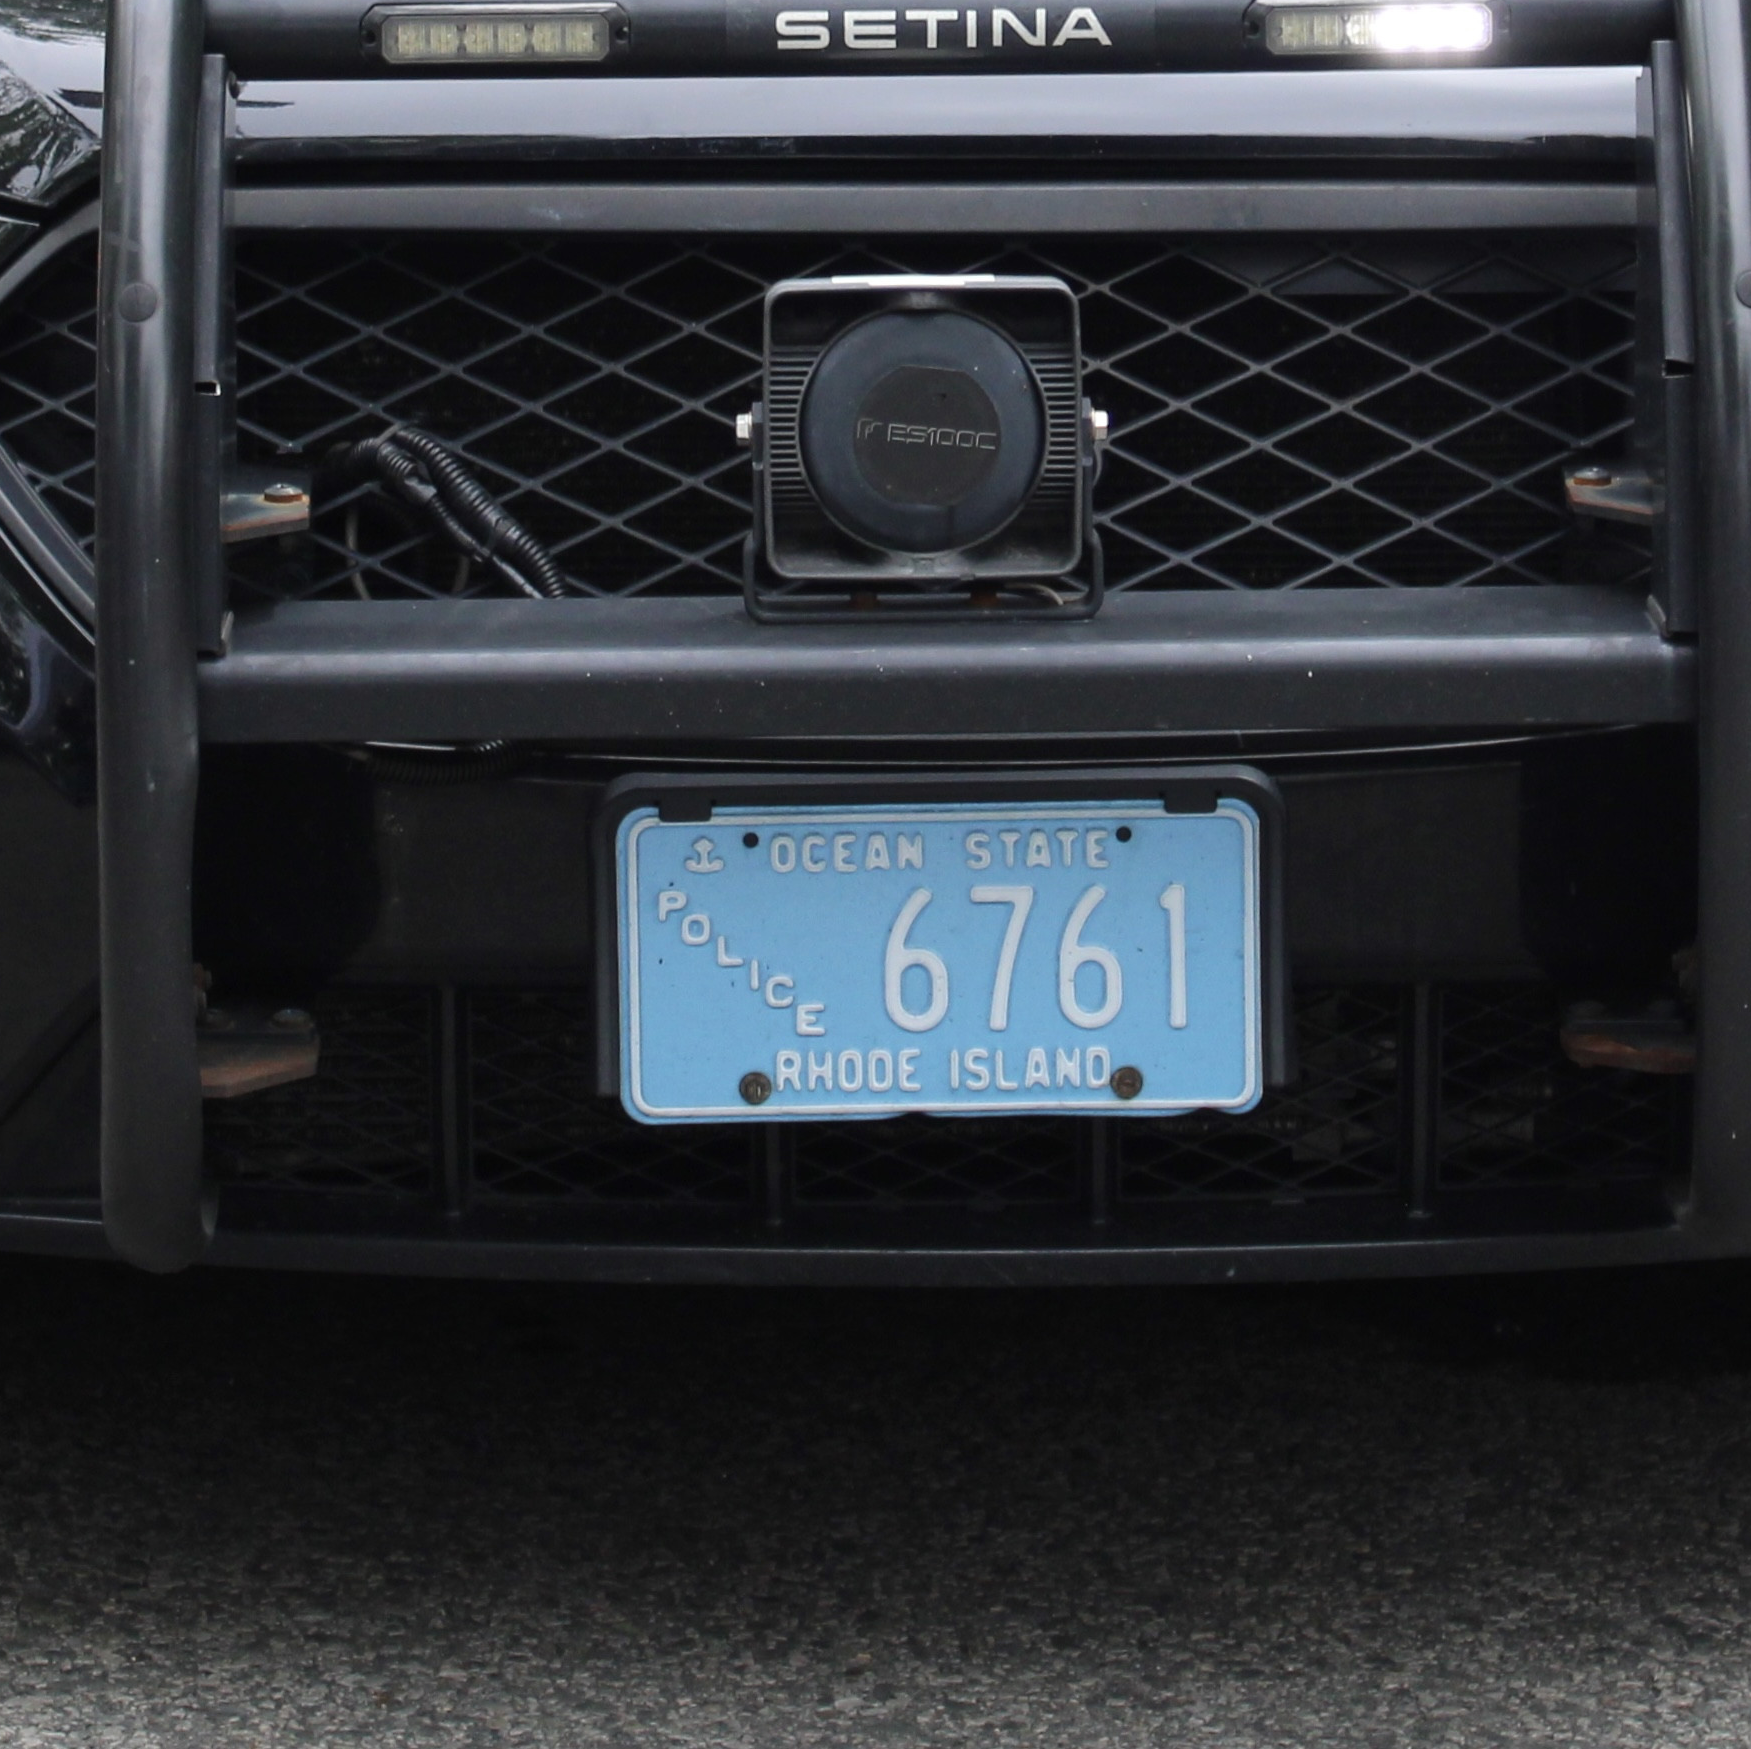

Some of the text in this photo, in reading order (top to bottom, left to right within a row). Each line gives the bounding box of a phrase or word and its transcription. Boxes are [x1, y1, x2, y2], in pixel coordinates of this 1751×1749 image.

[775, 7, 1112, 50] SETINA
[887, 423, 997, 450] ES100C
[769, 828, 1109, 872] OCEAN STATE
[658, 890, 826, 1036] POLICE
[884, 883, 1187, 1033] 6761
[776, 1046, 1112, 1092] RHODE ISLAND
